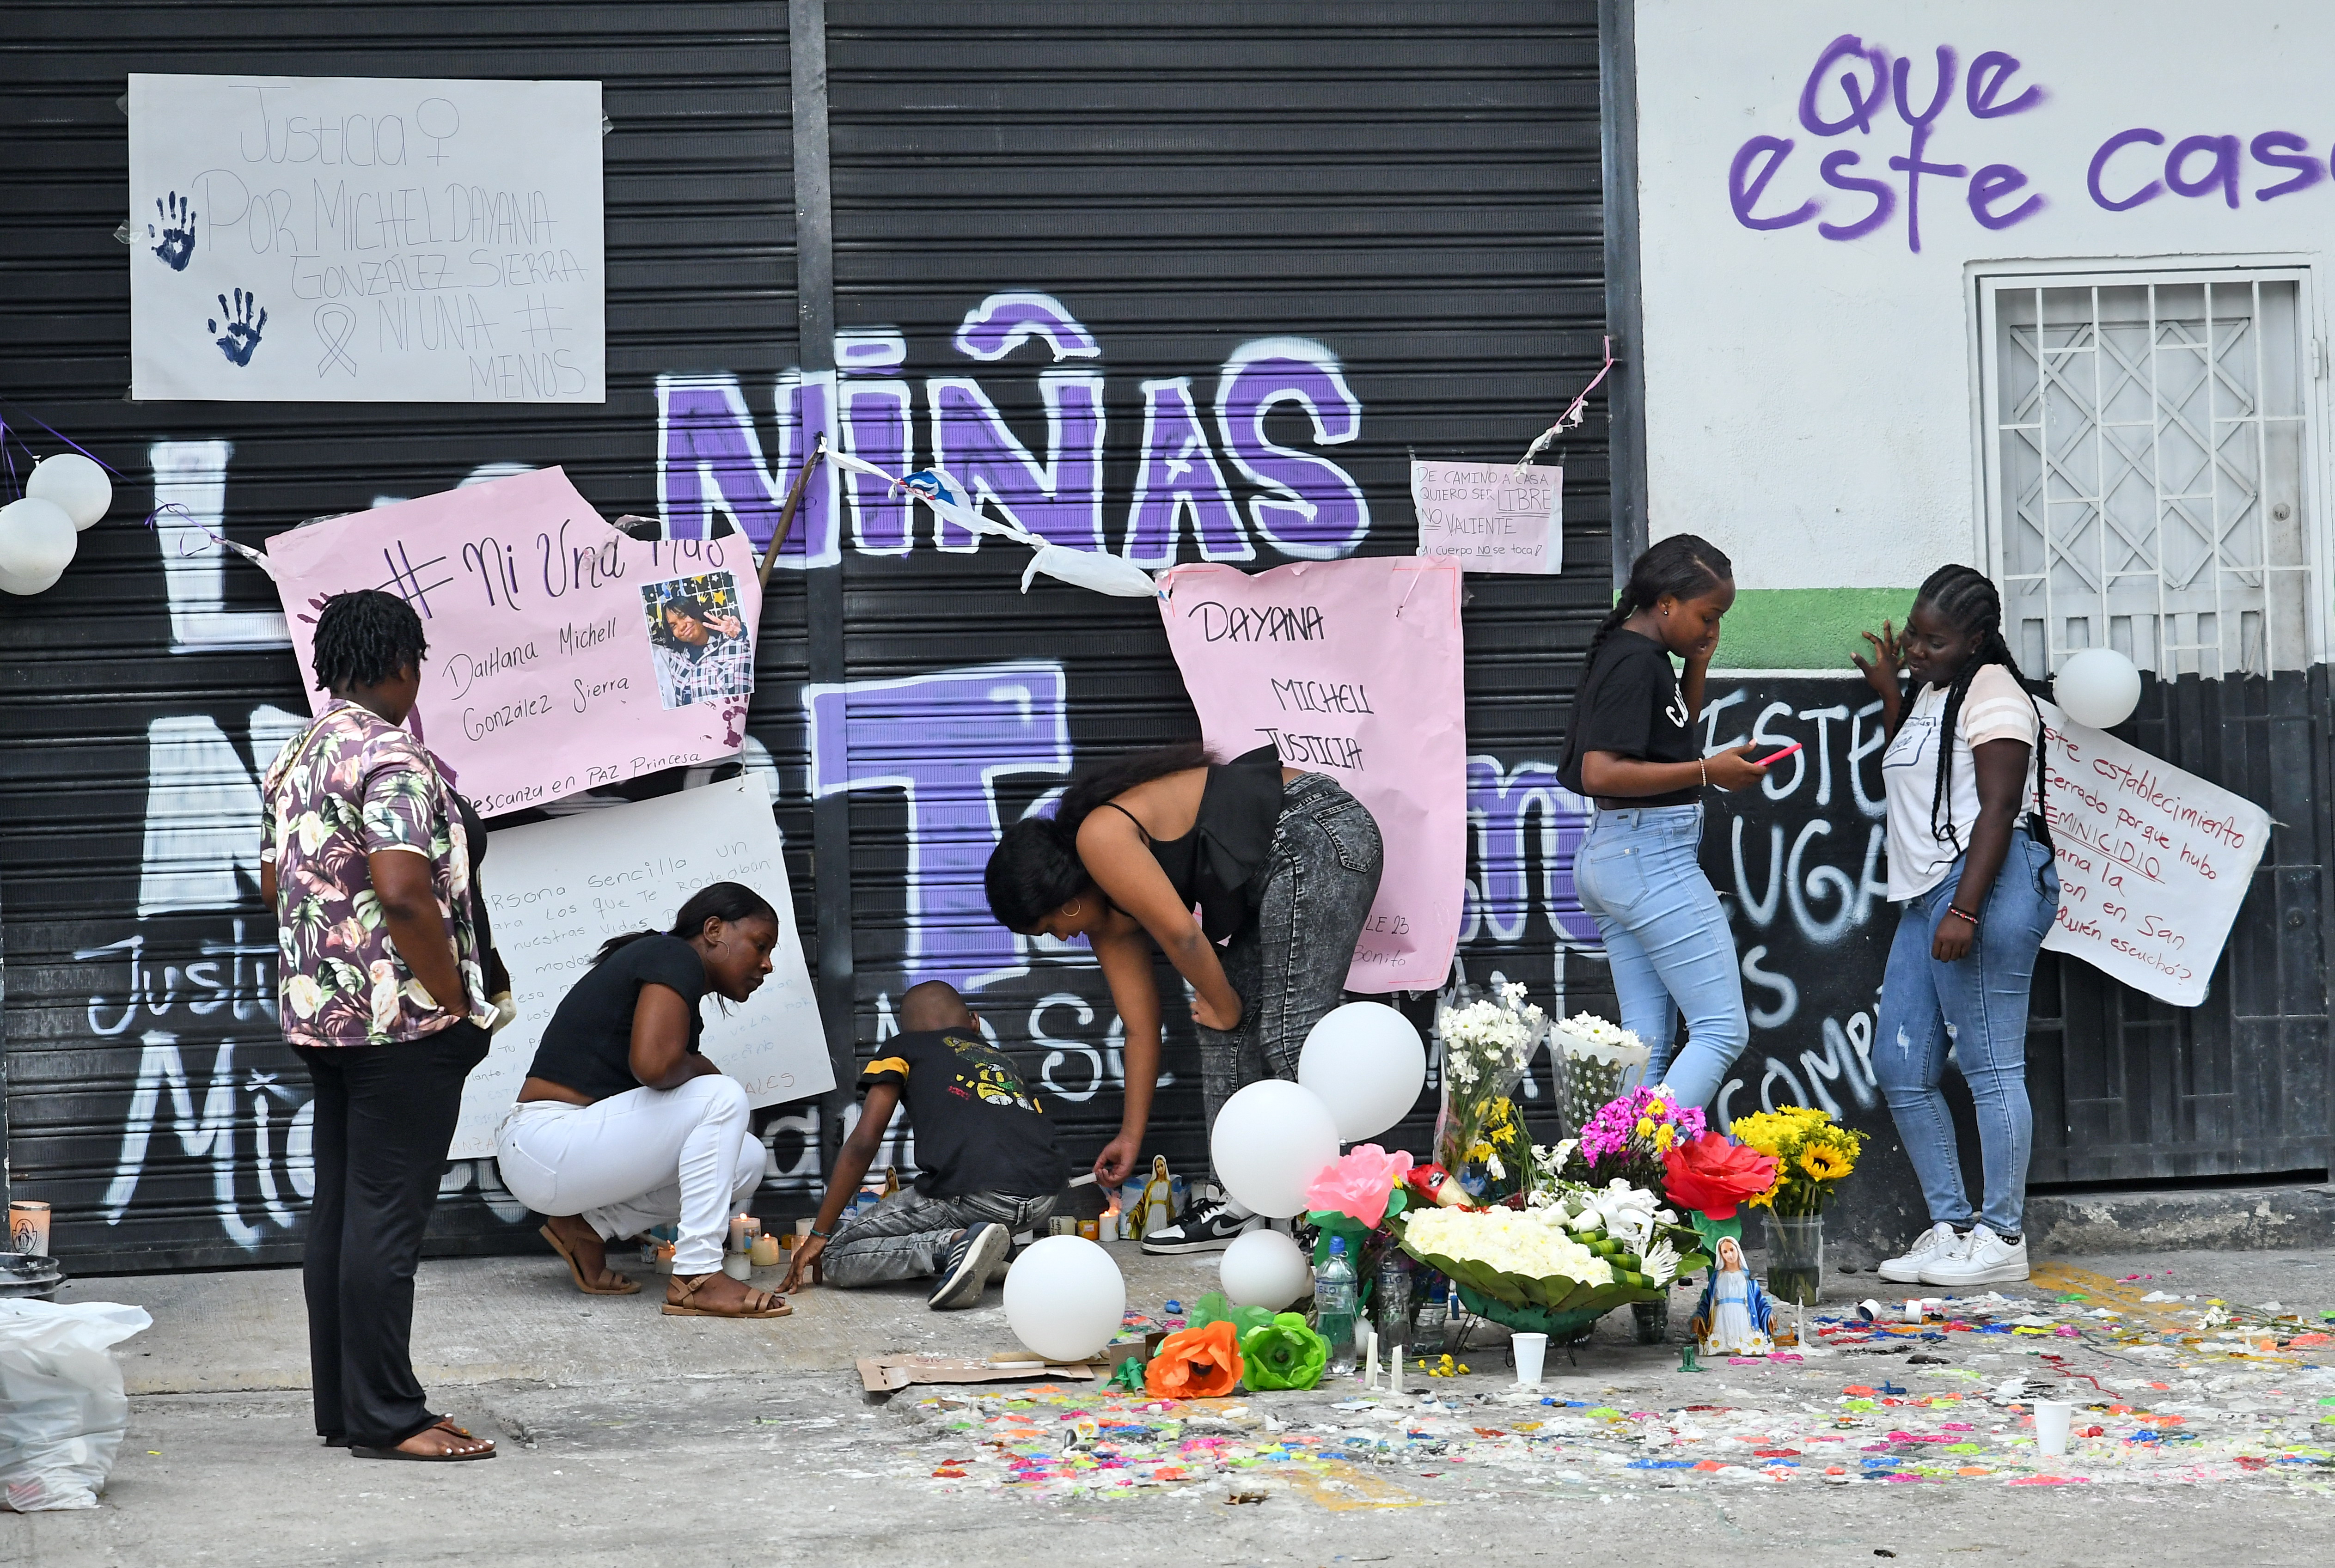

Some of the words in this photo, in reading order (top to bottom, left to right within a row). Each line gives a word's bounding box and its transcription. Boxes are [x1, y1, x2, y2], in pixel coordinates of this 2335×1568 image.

[1729, 124, 2048, 254] este
[2087, 128, 2335, 211] cas
[465, 249, 589, 287] SIERRA
[469, 349, 586, 399] MENOS
[1416, 467, 1437, 482] DE
[1444, 470, 1497, 484] CAMINO
[1502, 474, 1510, 484] A
[1516, 473, 1549, 485] CASA
[1419, 487, 1467, 501] QUIERO
[1472, 489, 1495, 500] SER
[1498, 488, 1551, 511] LIBRE
[1421, 507, 1442, 525] NO
[1445, 513, 1516, 536] VALIENTE
[1478, 545, 1491, 555] NO
[560, 617, 617, 654] Michell
[1187, 601, 1325, 642] DAYANA
[463, 694, 552, 741] González
[574, 675, 630, 714] Sierra
[1255, 727, 1365, 772] JUSTICIA
[2045, 727, 2081, 763] ste
[552, 776, 575, 793] en
[586, 765, 620, 785] PAZ
[630, 753, 702, 777] Princesa
[2051, 837, 2091, 874] ana
[2102, 862, 2125, 897] la
[2181, 843, 2217, 880] hubo
[493, 920, 523, 930] ara
[514, 927, 585, 950] nuestras
[1391, 915, 1409, 934] 23
[2103, 902, 2127, 923] en
[2137, 915, 2185, 950] San
[1351, 945, 1406, 967] Bonito
